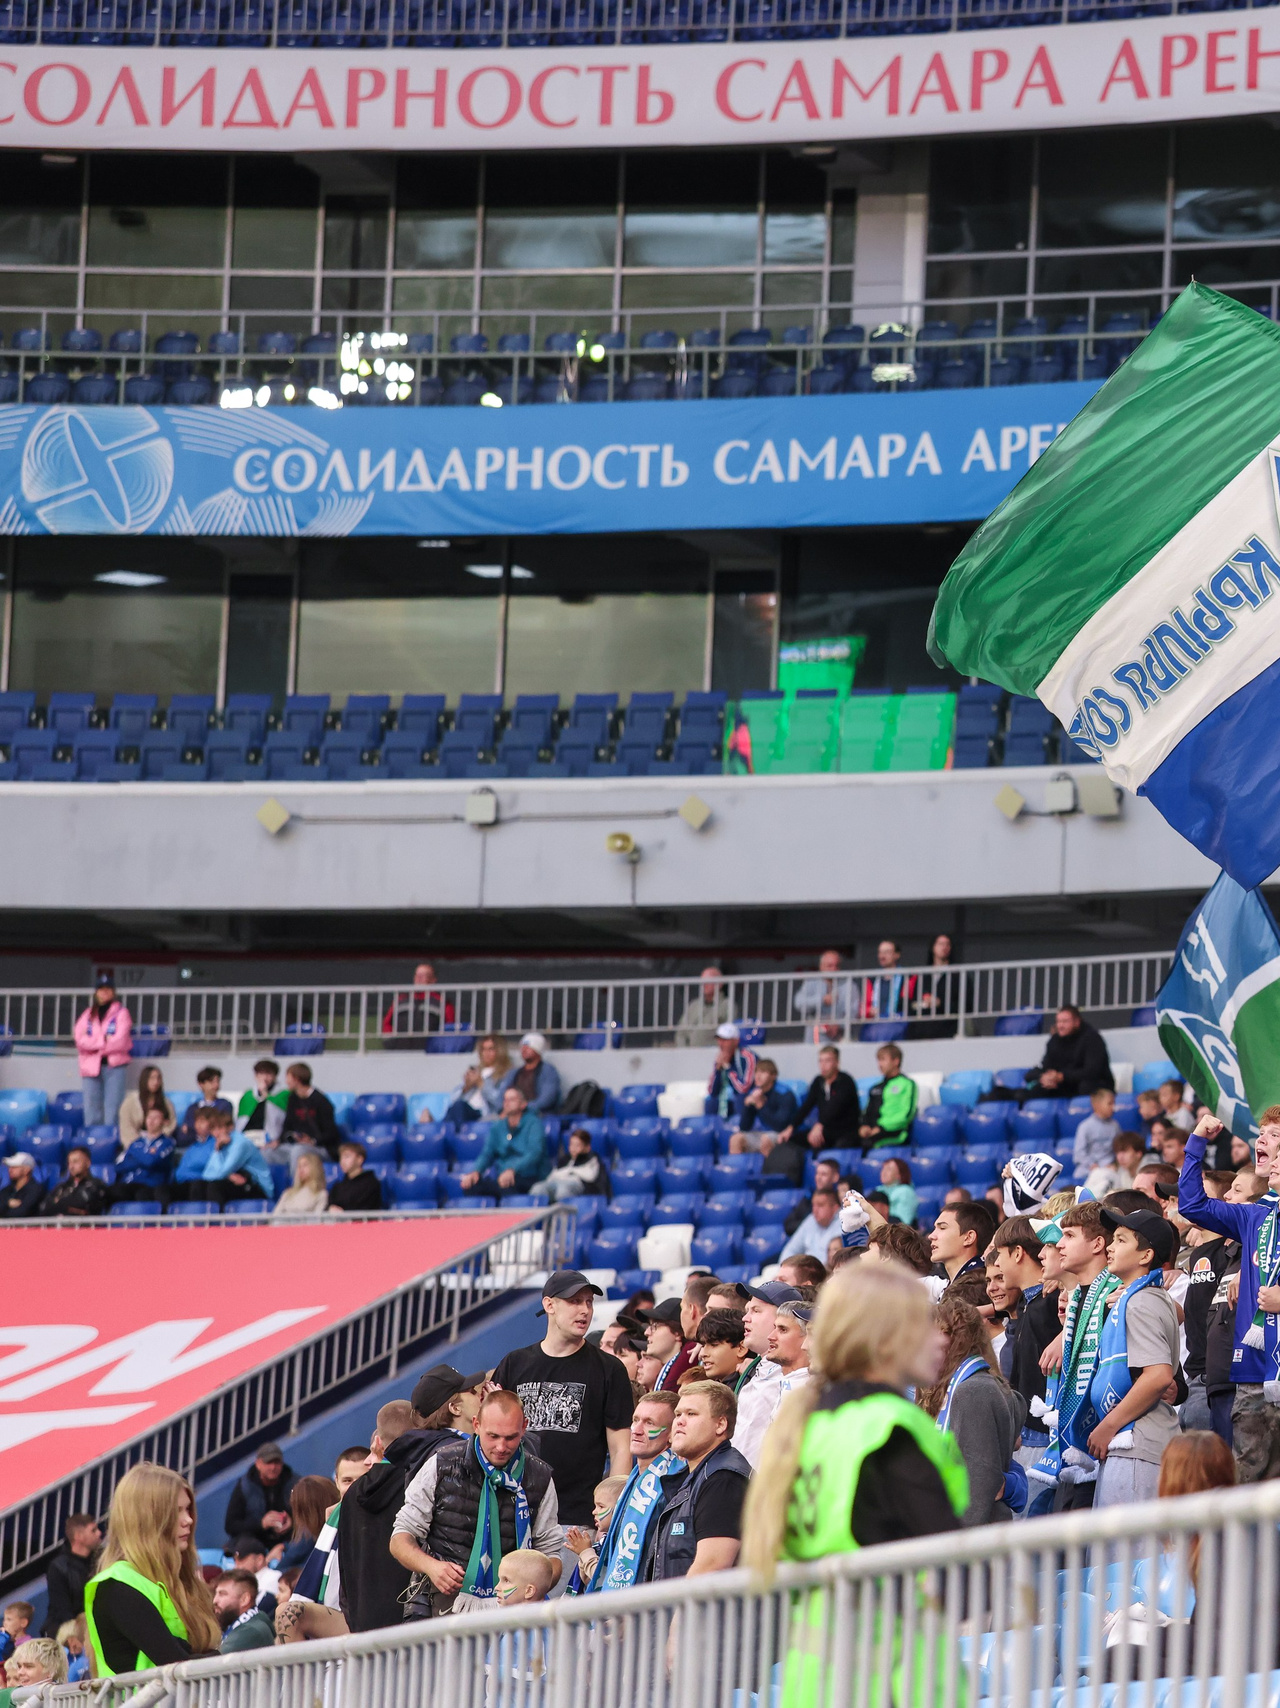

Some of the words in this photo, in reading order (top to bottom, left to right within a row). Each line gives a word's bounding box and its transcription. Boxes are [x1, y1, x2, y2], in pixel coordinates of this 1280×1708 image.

[0, 61, 677, 131] ОЛИДАРНОСТЬ
[715, 45, 1065, 124] САМАРА
[232, 443, 690, 494] СОЛИДАРНОСТЬ
[712, 431, 942, 486] САМАРА
[961, 423, 1068, 474] АРЕ
